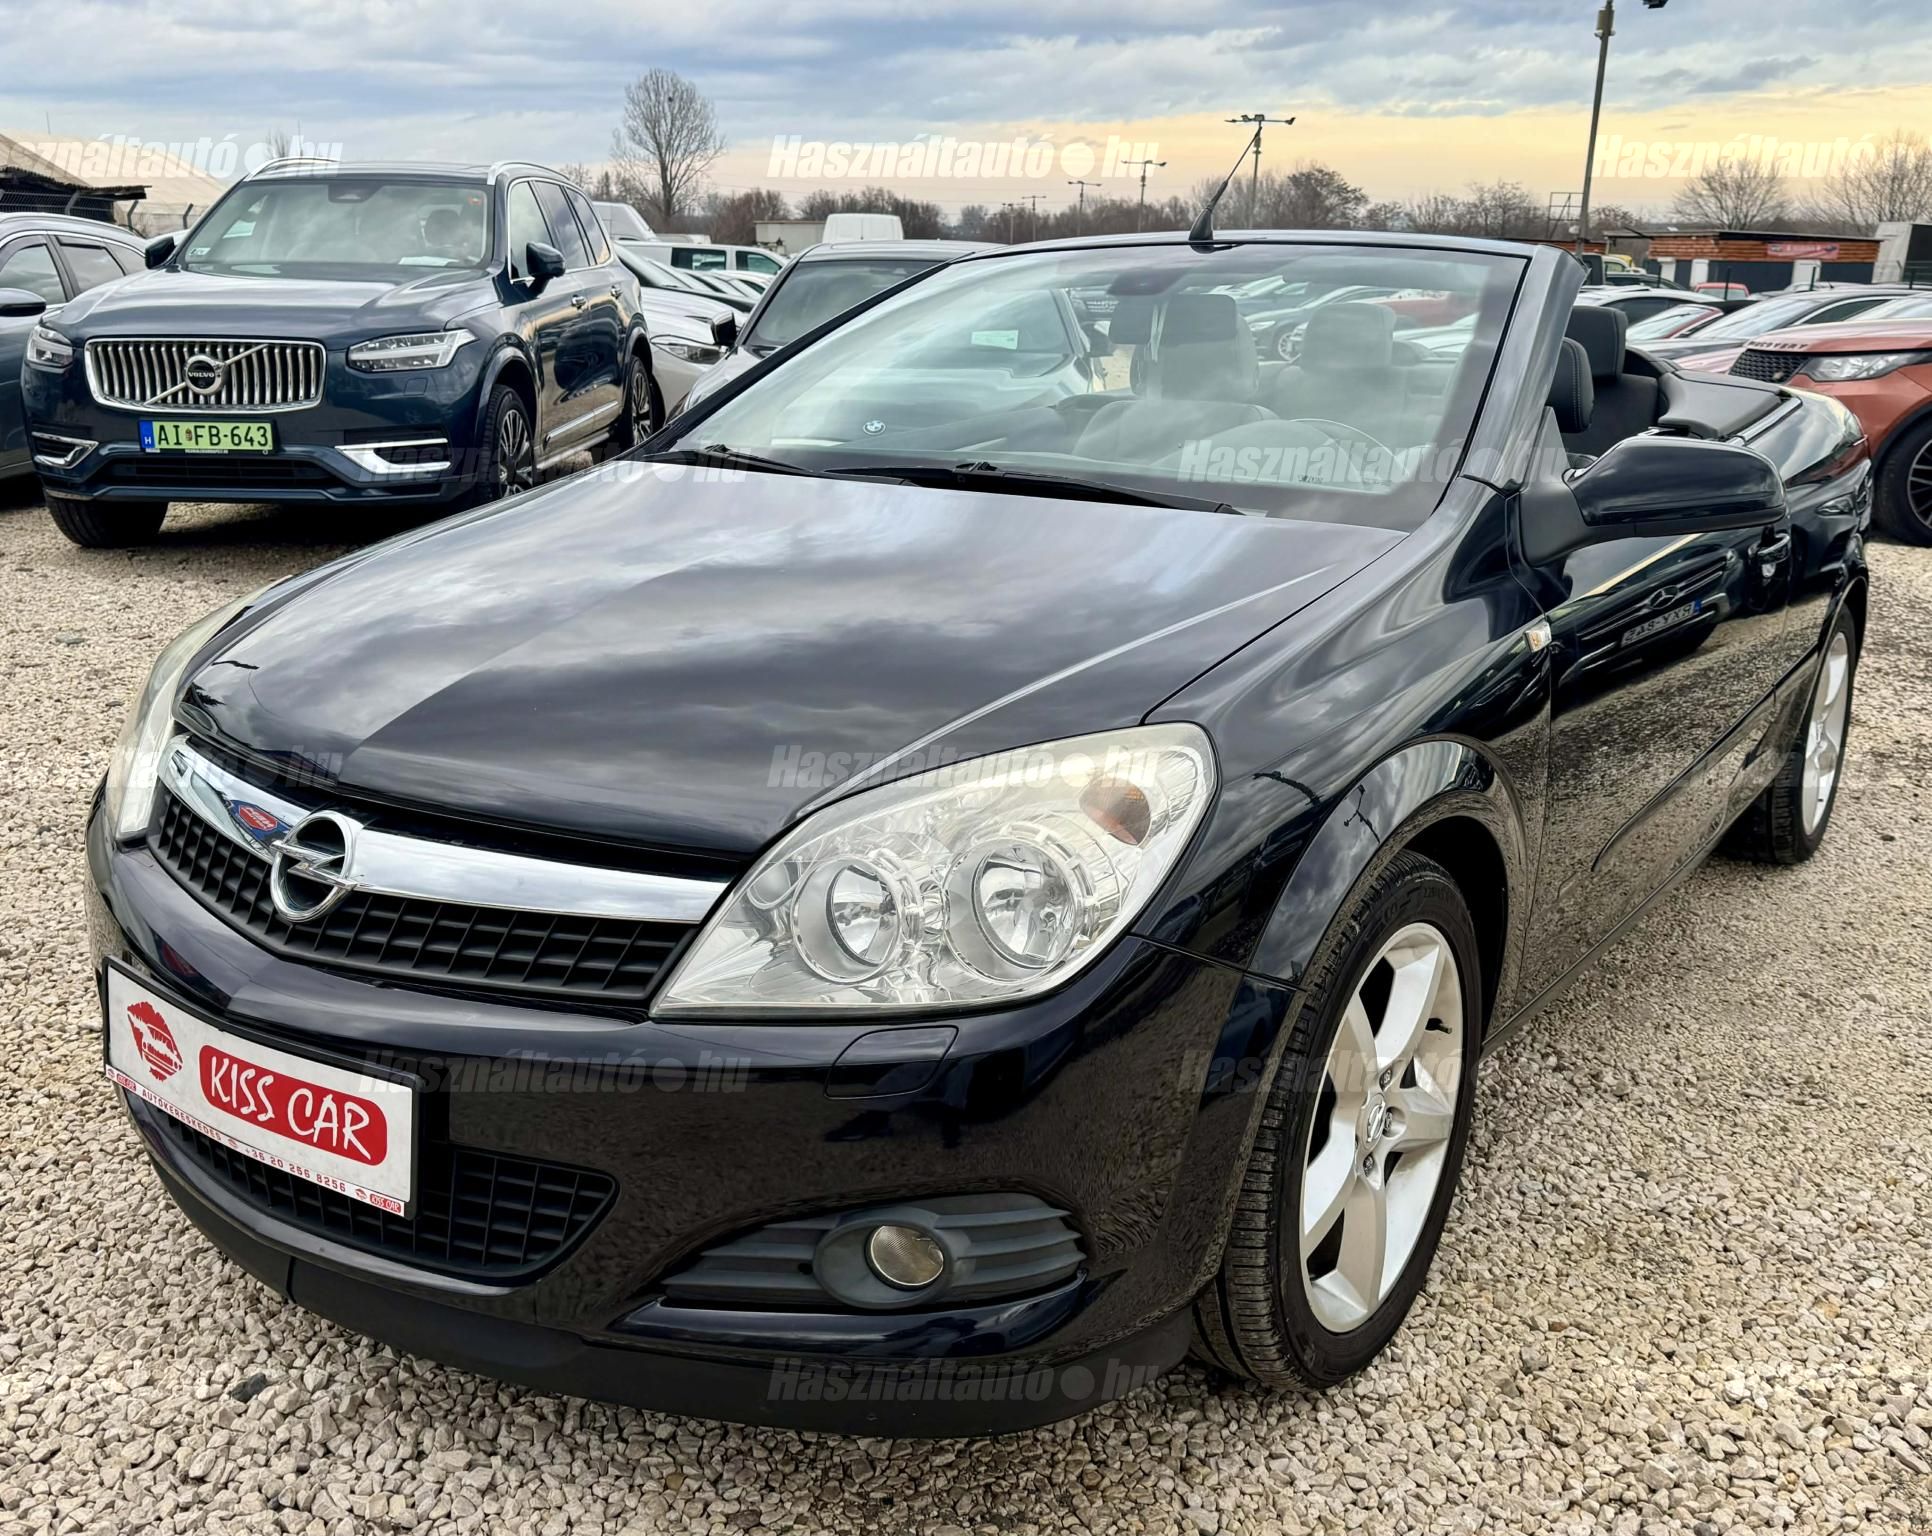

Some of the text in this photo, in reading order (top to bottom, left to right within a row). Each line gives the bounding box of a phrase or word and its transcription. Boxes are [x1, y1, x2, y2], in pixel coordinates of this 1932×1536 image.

[144, 424, 268, 447] H AI FB-643
[211, 1056, 371, 1161] KISS CAR
[270, 1156, 284, 1168] 20
[289, 1163, 311, 1178] 256
[316, 1173, 346, 1192] 8256
[371, 1194, 400, 1213] KISS CAR
